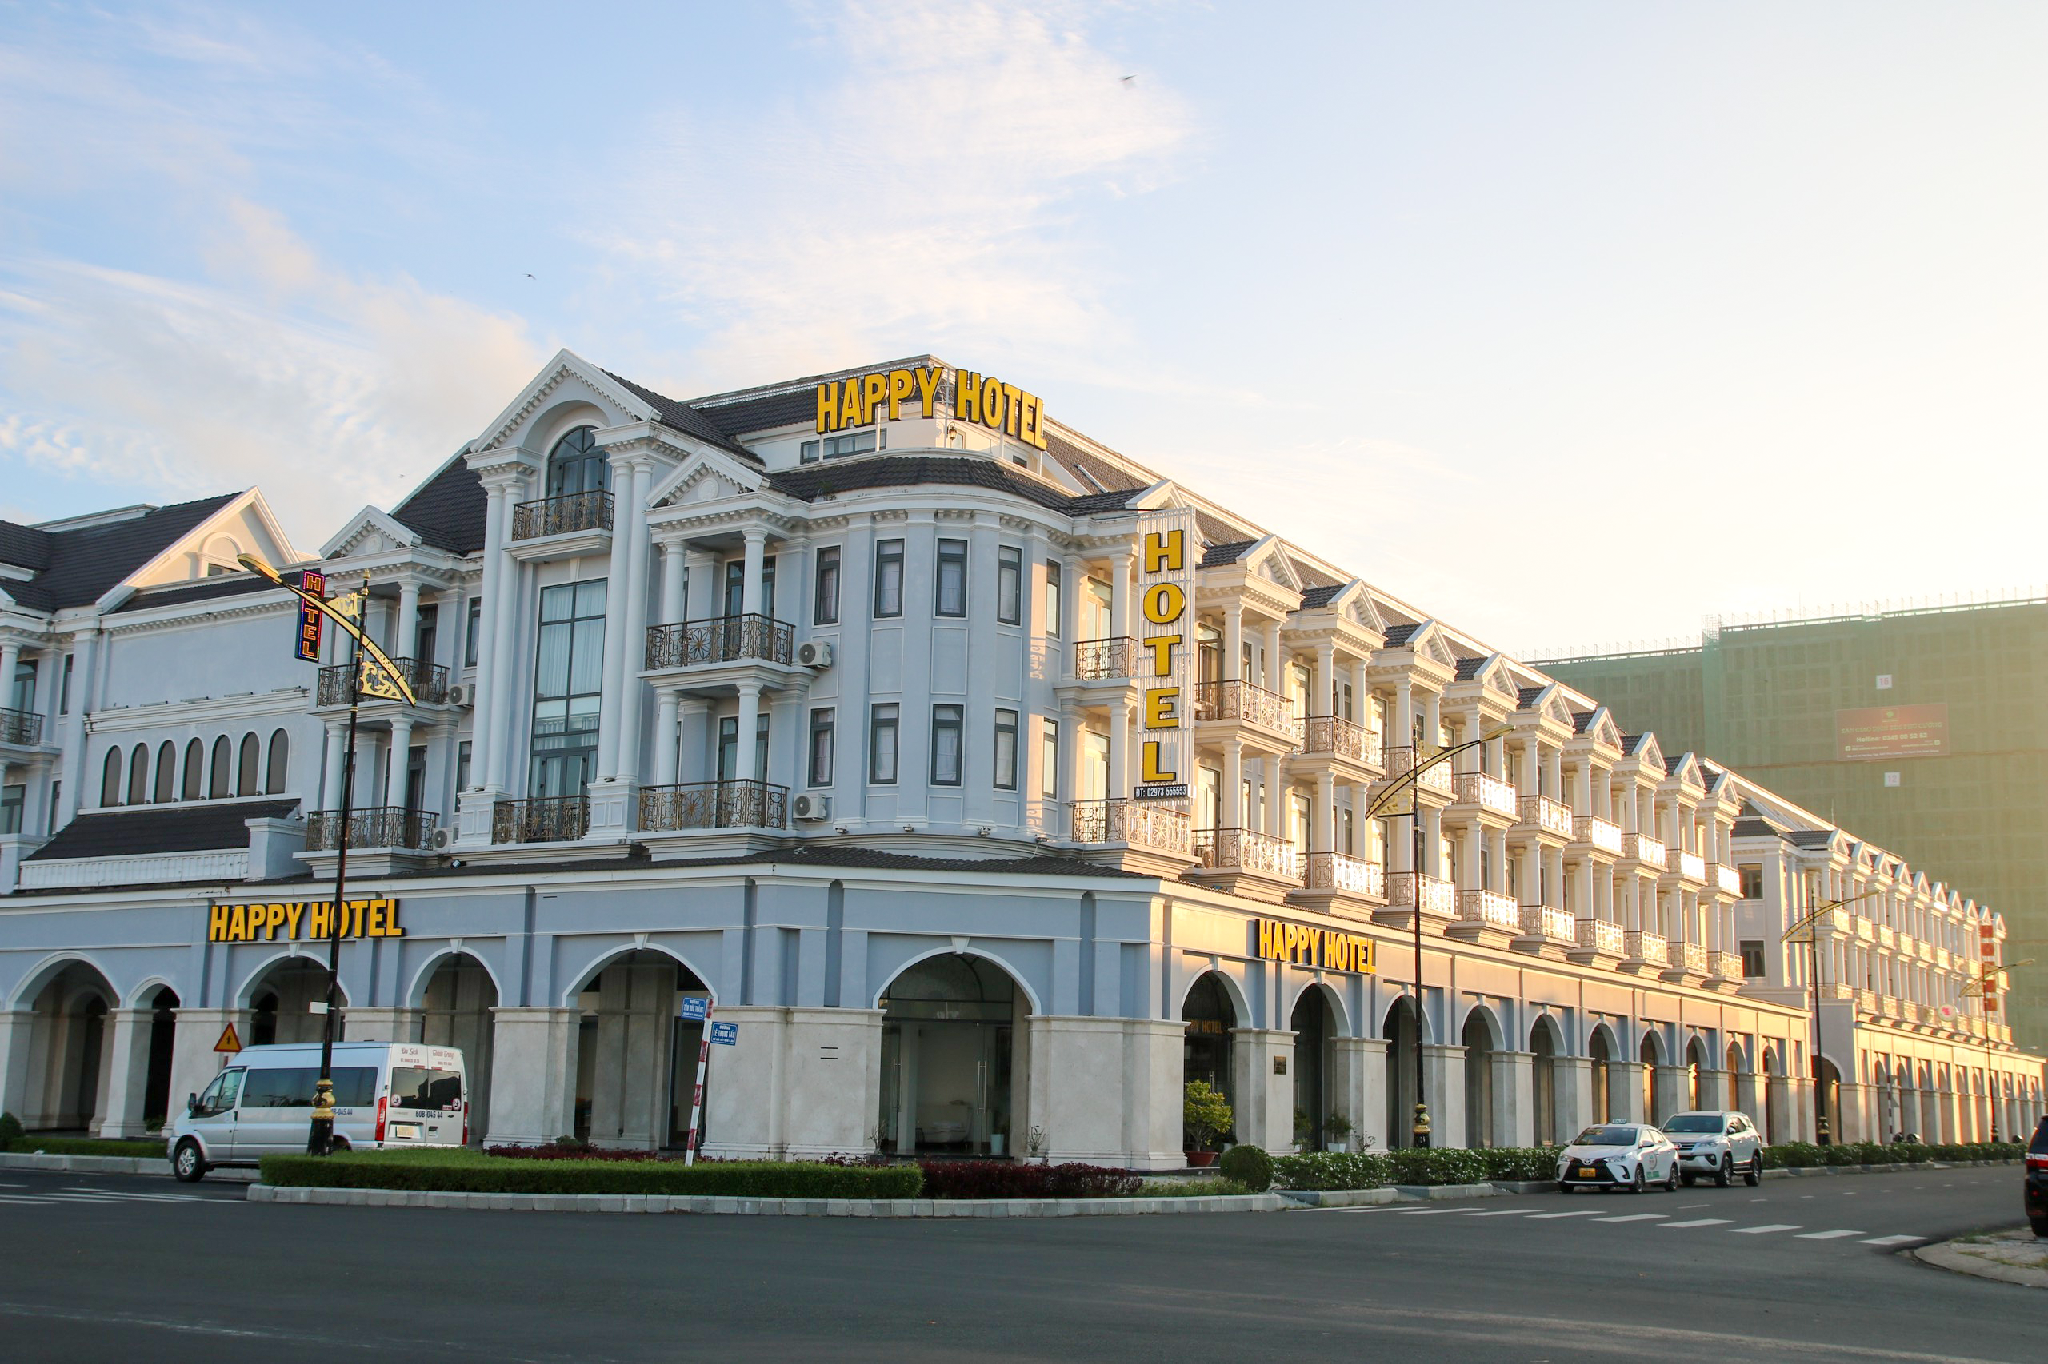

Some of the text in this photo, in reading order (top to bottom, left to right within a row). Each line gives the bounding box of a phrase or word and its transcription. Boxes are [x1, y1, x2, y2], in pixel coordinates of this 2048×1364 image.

[816, 367, 1047, 451] HAPPY HOTEL
[1142, 529, 1186, 782] HOTEL
[209, 898, 406, 942] HAPPY HOTEL
[1259, 919, 1377, 975] HAPPY HOTEL
